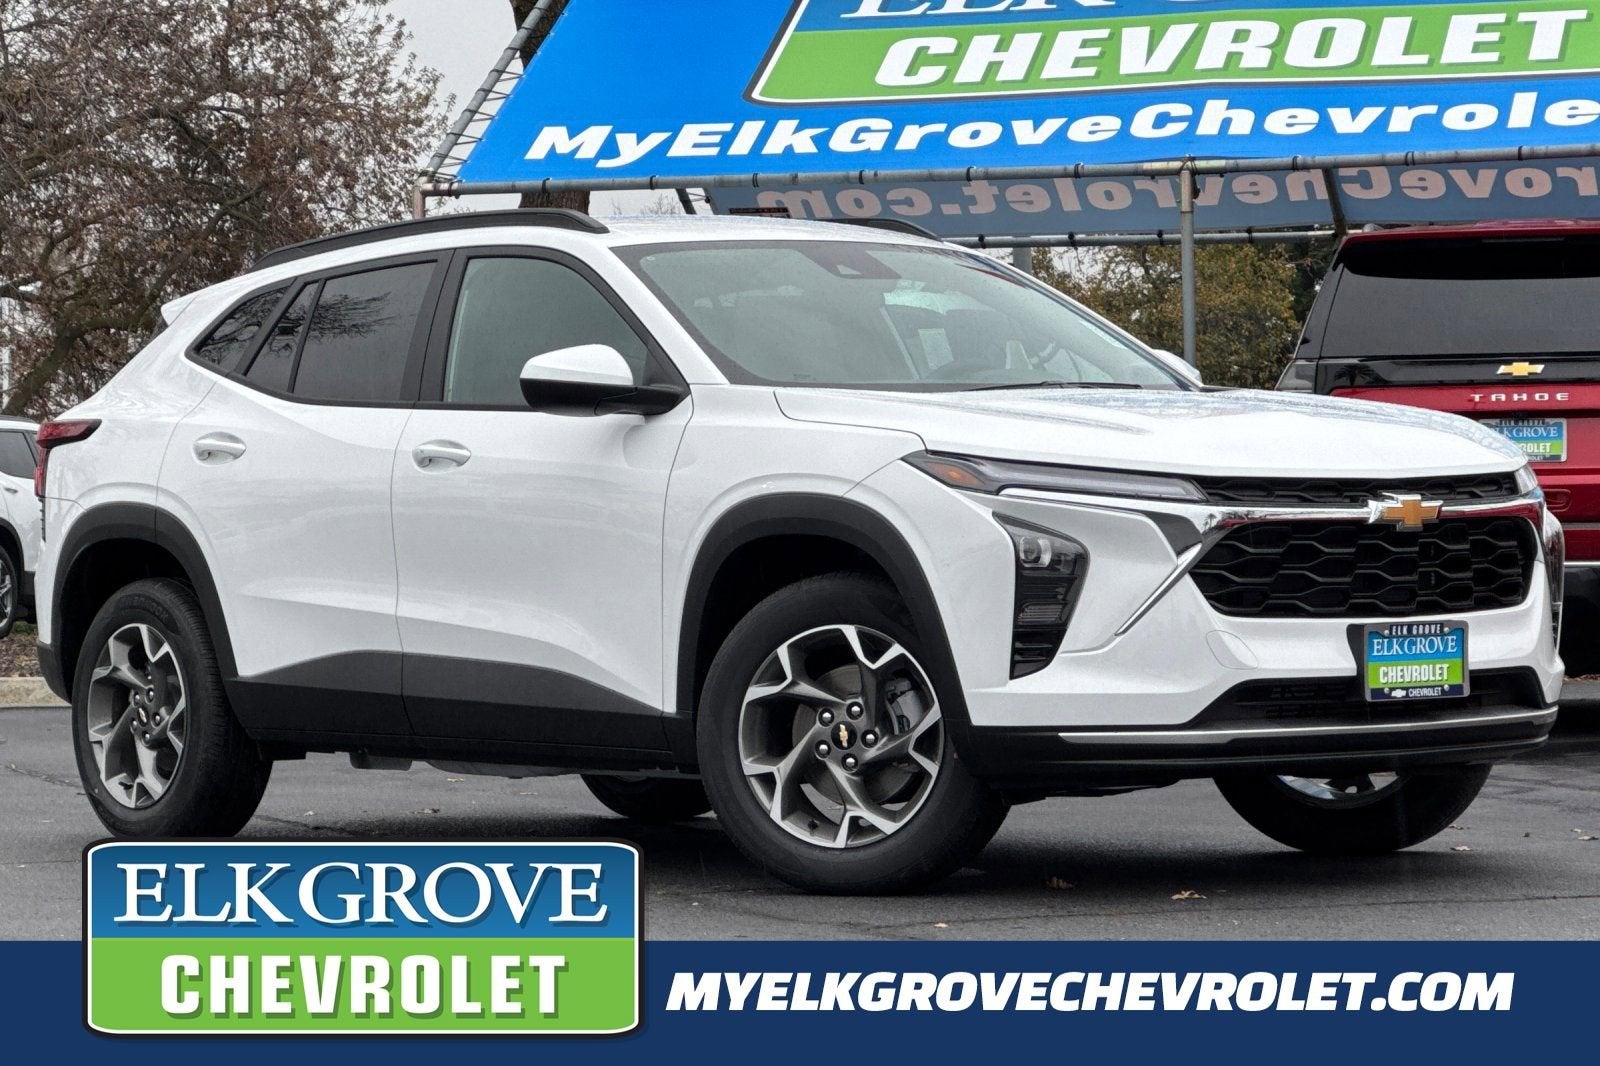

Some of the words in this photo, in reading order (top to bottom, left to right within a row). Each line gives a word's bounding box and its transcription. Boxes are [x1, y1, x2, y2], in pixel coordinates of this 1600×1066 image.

[875, 9, 1588, 88] CHEVROLET
[1470, 392, 1570, 402] TAHOE
[1512, 426, 1559, 438] GROVE
[1391, 625, 1409, 635] ELK
[1412, 624, 1441, 635] GROVE
[1372, 637, 1403, 656] ELK
[1403, 635, 1458, 655] GROVE
[1379, 663, 1450, 684] CHEVROLET
[1408, 686, 1442, 697] CHEVROLET
